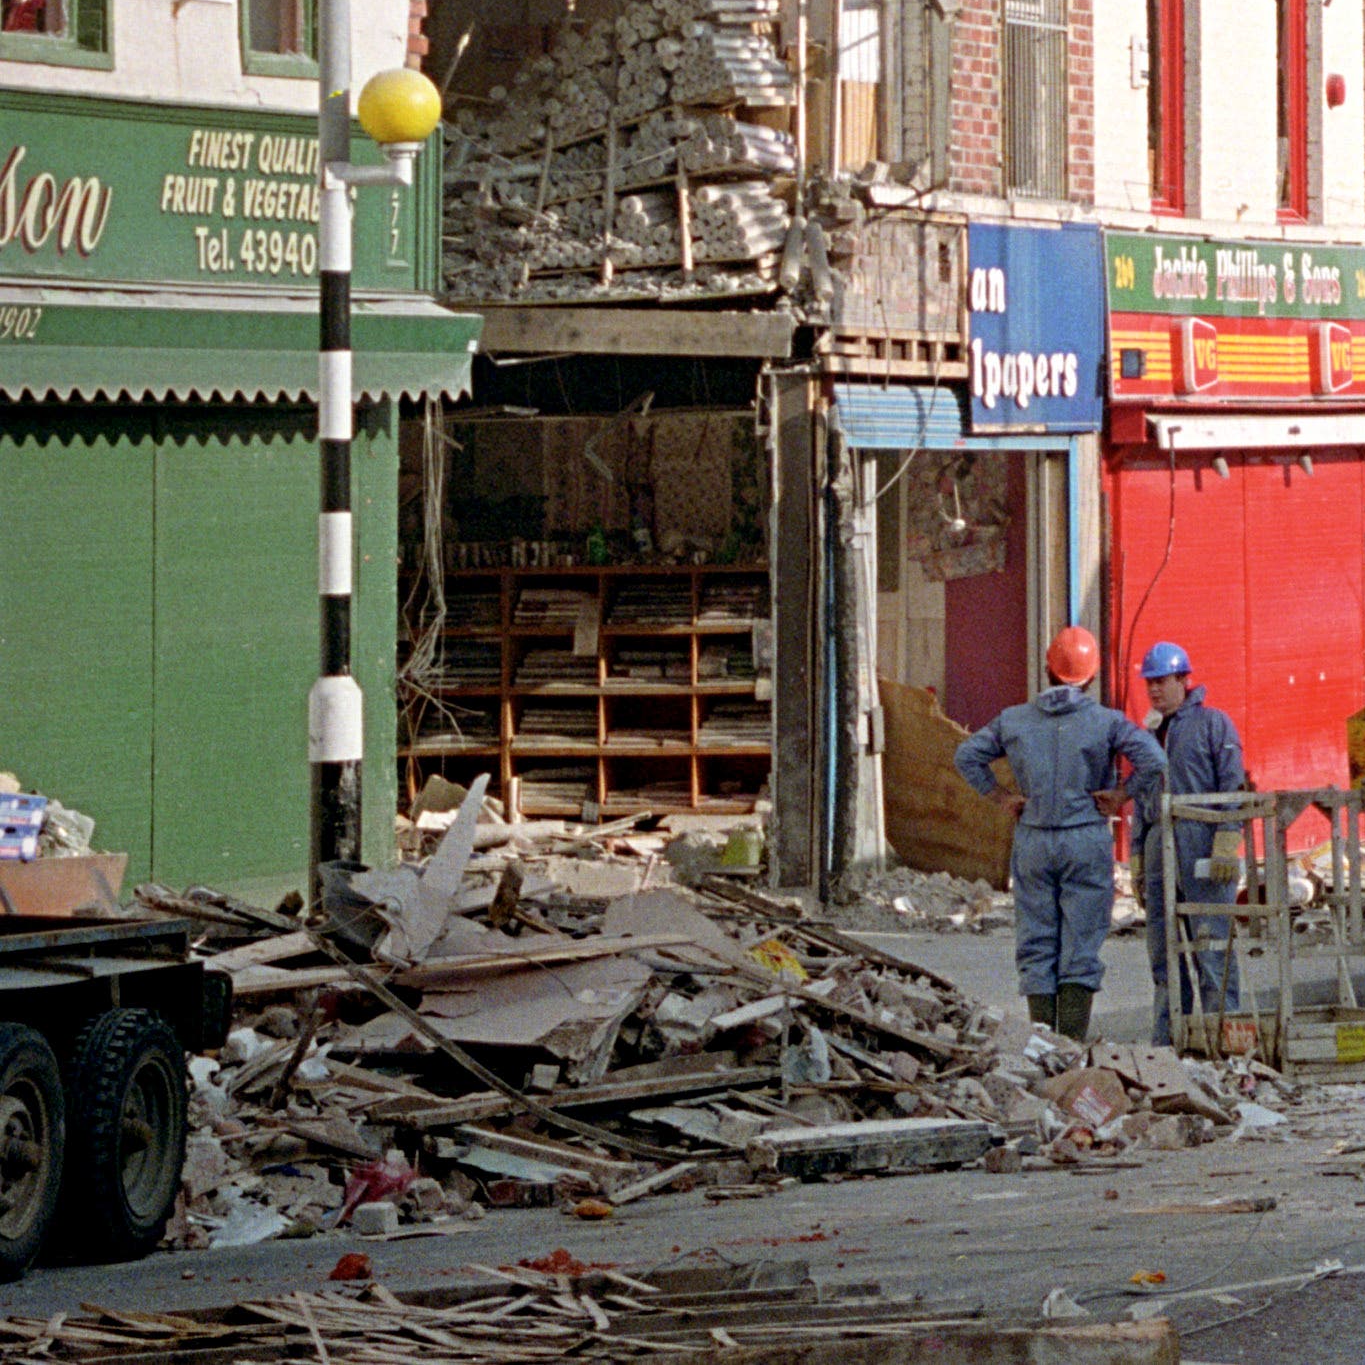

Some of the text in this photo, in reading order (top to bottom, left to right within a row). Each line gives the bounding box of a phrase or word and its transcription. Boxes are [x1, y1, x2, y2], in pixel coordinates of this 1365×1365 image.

[188, 130, 320, 175] FINEST QUALIT
[161, 175, 219, 216] FRUIT
[222, 178, 236, 217] &
[195, 226, 235, 274] Tel.
[1153, 246, 1208, 301] Jackie
[1216, 249, 1277, 315] Phillips
[1282, 252, 1296, 305] &
[1301, 250, 1341, 306] Sons
[1194, 338, 1216, 371] VG
[1330, 341, 1352, 371] VG
